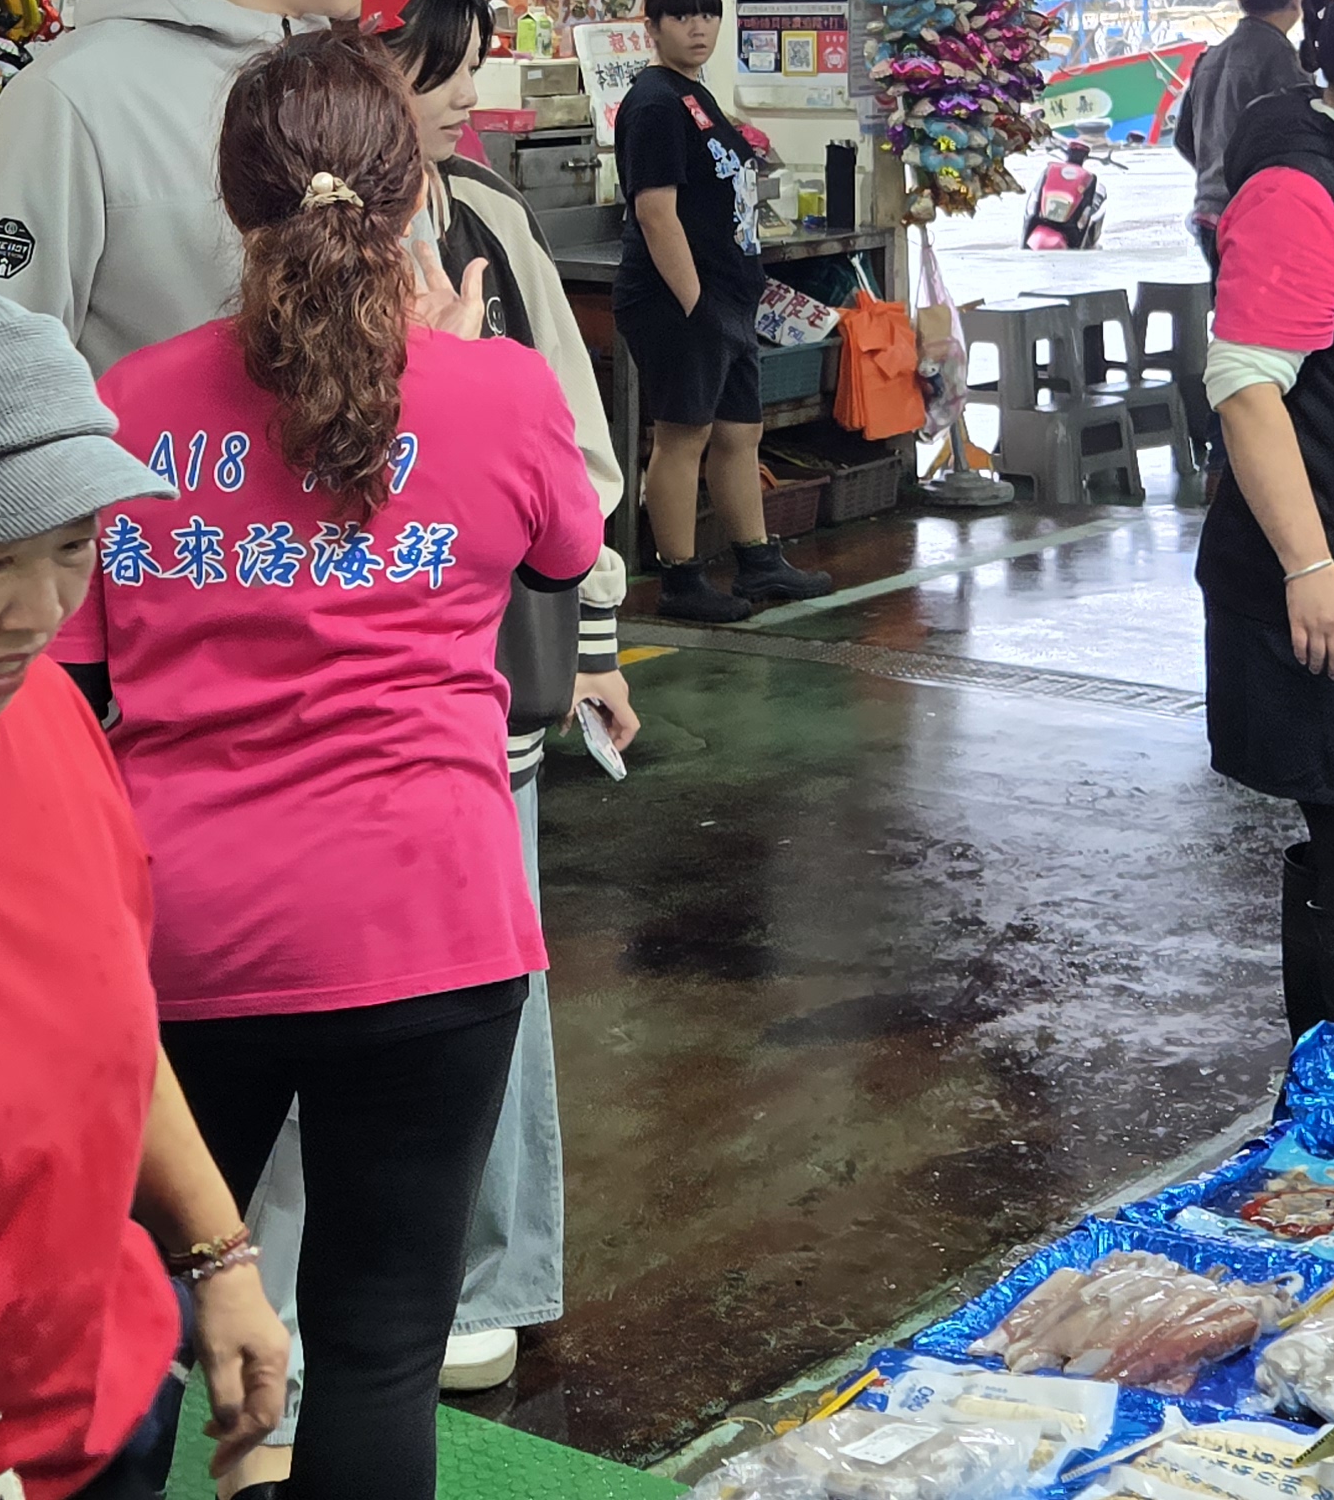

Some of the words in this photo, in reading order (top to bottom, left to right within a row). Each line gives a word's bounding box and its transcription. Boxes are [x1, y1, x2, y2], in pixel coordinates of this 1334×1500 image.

[148, 430, 251, 493] A18
[100, 514, 459, 590] 春來活海鮮
